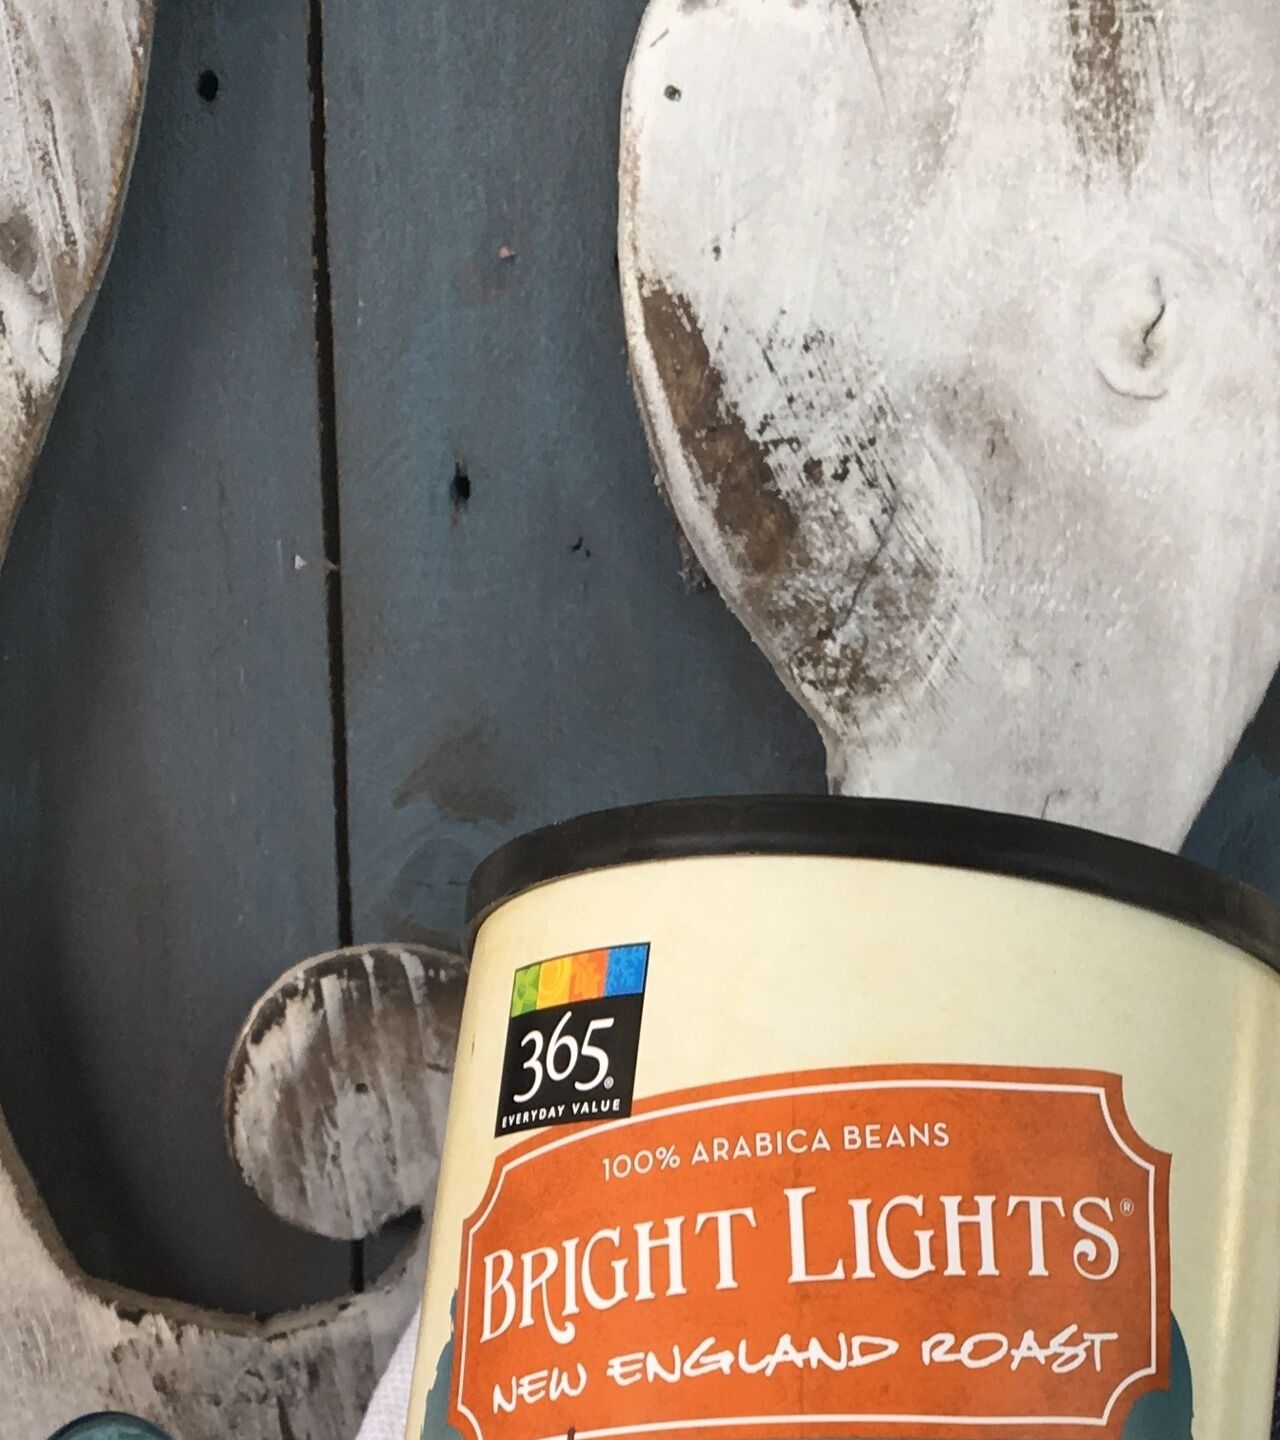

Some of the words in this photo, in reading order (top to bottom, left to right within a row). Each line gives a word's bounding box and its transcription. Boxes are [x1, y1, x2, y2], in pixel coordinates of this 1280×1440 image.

[501, 1103, 566, 1129] EVERYDAY
[571, 1098, 621, 1115] VALUE
[602, 1144, 680, 1181] 100%
[691, 1127, 831, 1163] ARABICA
[843, 1122, 951, 1149] BEANS
[479, 1206, 757, 1345] BRIGHT
[492, 1360, 588, 1414] NEW
[606, 1331, 901, 1386] ENGLAND
[921, 1323, 1119, 1374] ROAST
